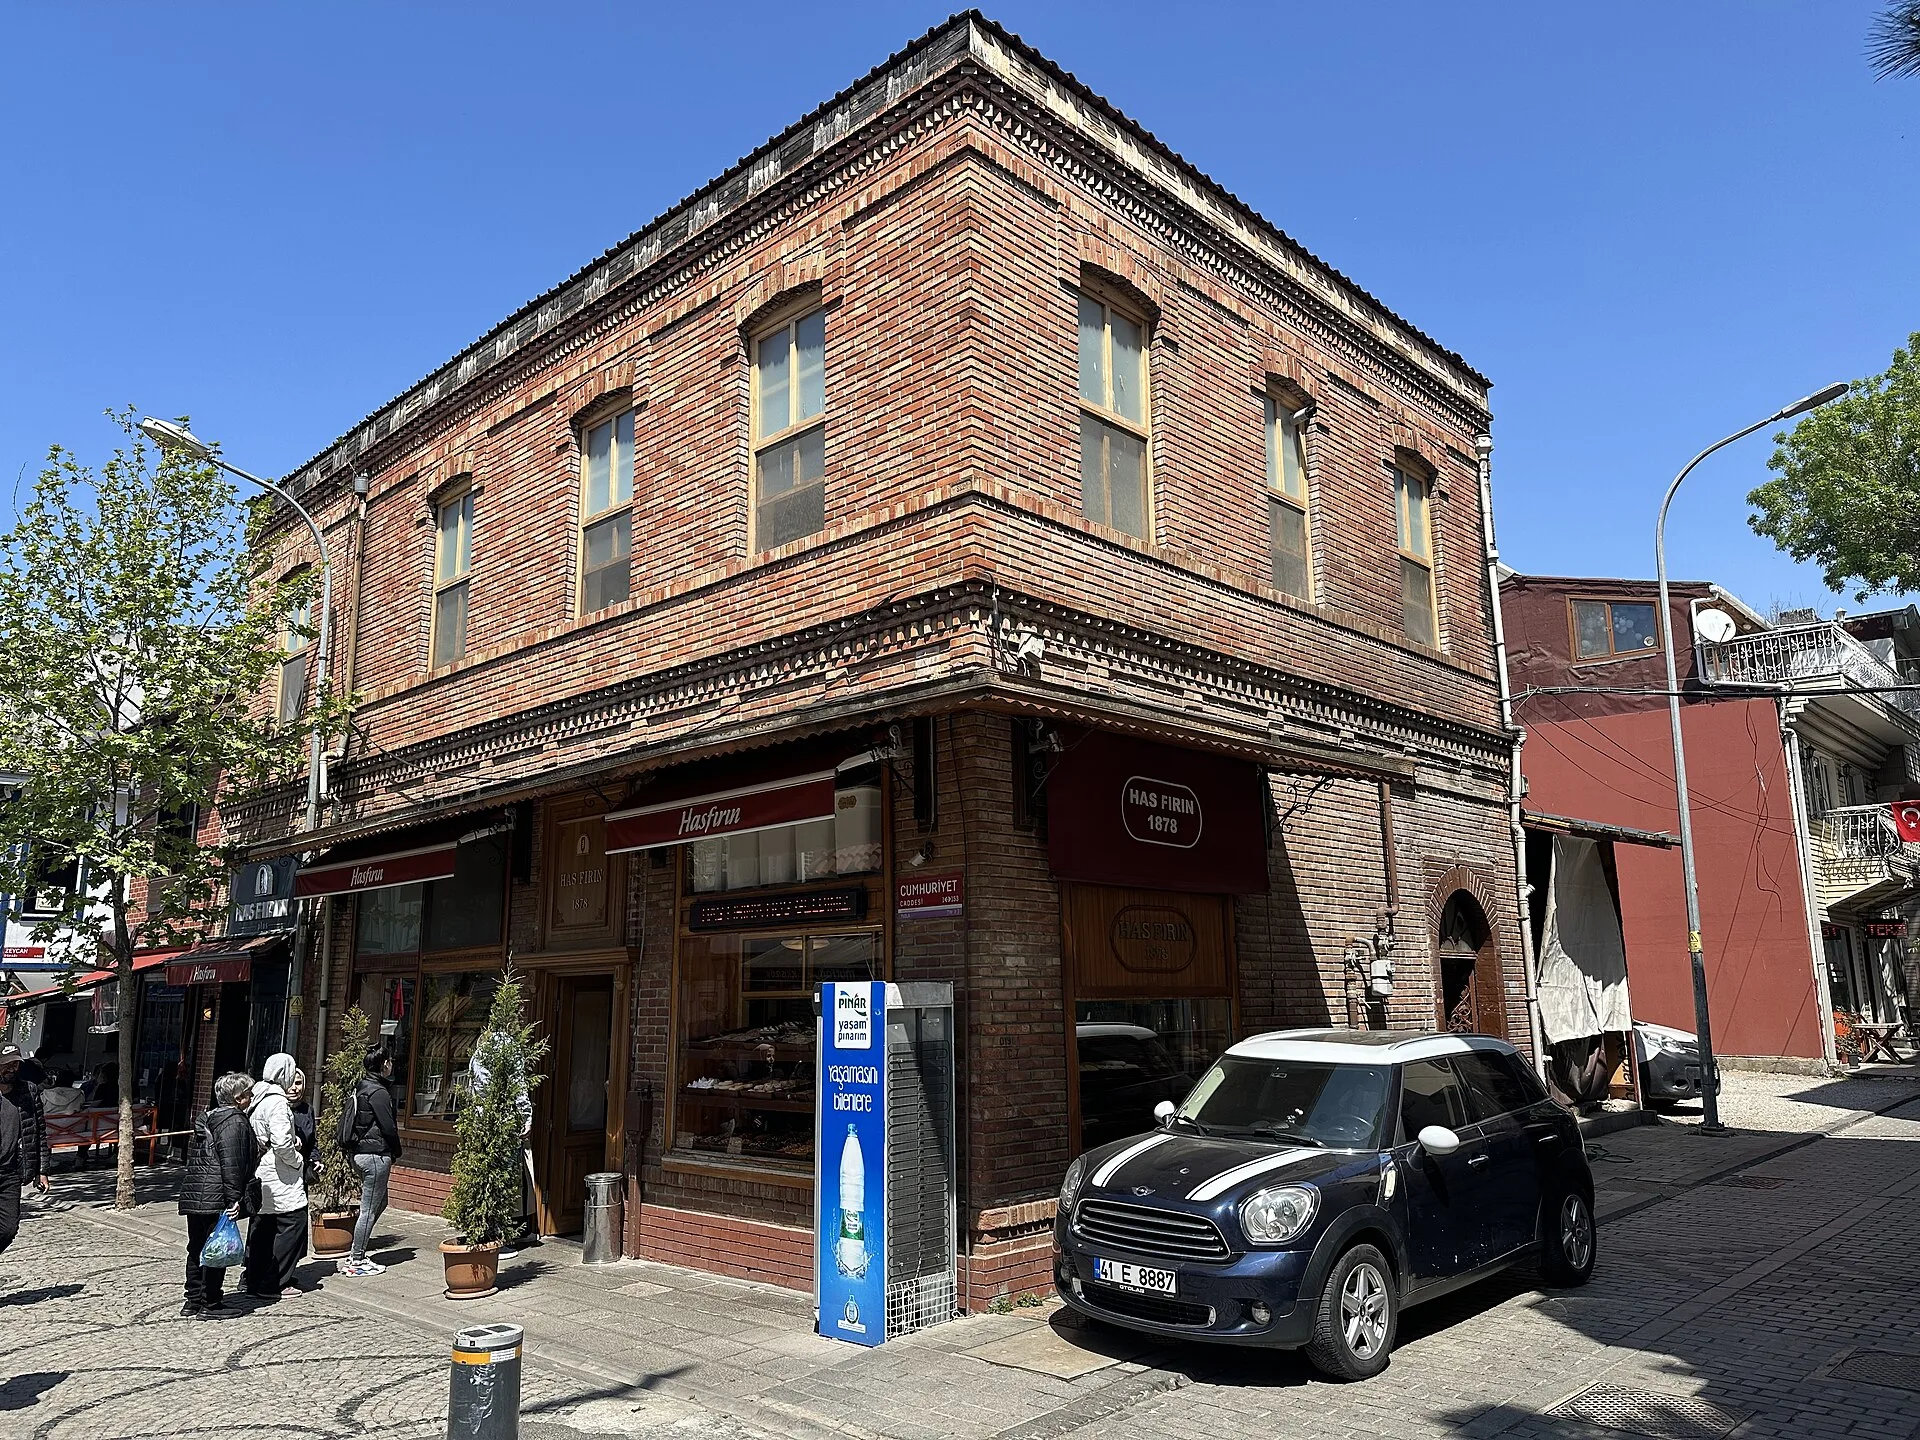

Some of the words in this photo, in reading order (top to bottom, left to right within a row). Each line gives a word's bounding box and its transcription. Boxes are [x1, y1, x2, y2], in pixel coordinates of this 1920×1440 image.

[1129, 788, 1158, 808] HAS
[1161, 794, 1194, 815] FIRIN
[1147, 814, 1178, 834] 1878
[560, 872, 577, 887] HAS
[579, 868, 604, 885] FIRIN
[900, 879, 958, 897] CUMHURİYET
[572, 897, 588, 910] 1878
[838, 1020, 867, 1032] yaşam
[1101, 1260, 1114, 1280] 41
[1121, 1264, 1132, 1284] E
[1139, 1267, 1175, 1291] 8887
